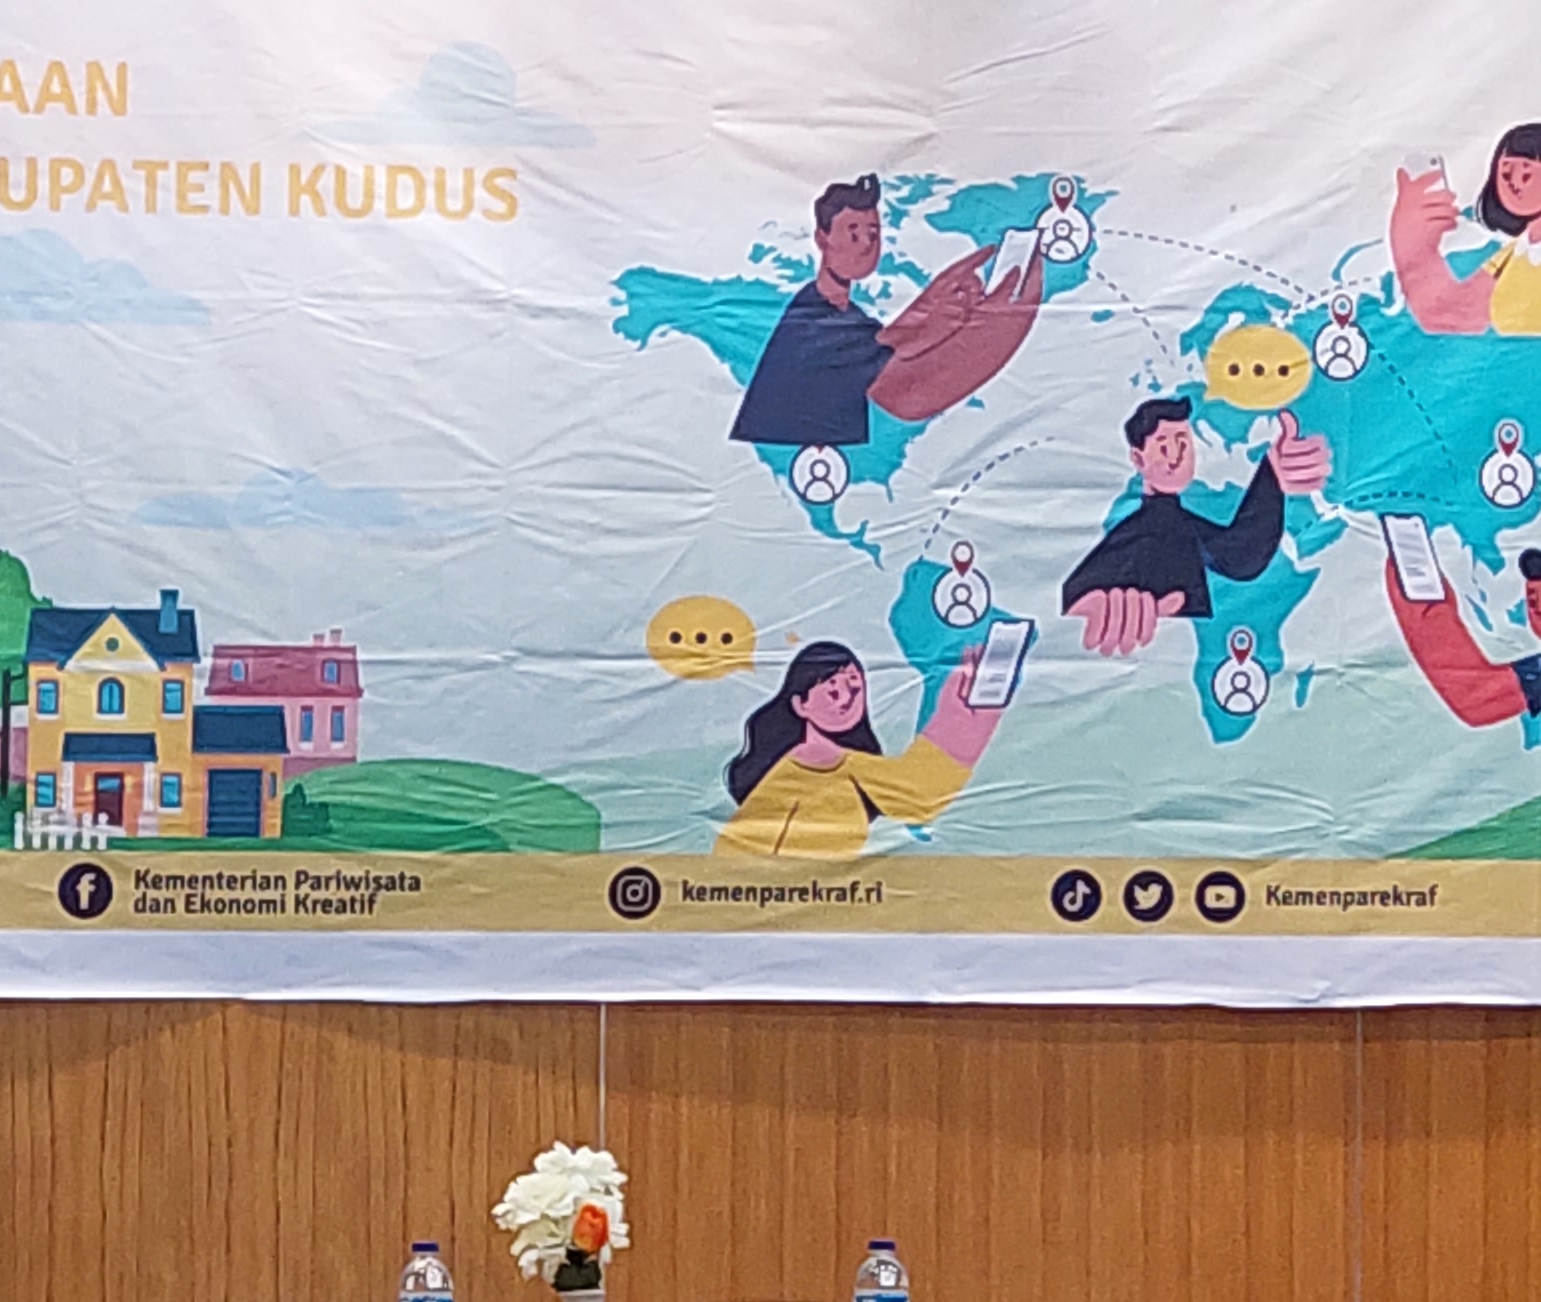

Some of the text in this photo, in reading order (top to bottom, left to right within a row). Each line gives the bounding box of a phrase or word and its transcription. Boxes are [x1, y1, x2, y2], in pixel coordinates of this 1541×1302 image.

[288, 163, 519, 222] KUDUS
[133, 868, 422, 893] Kementerian Pariwisata
[681, 879, 884, 908] kemenparekraf.ri
[133, 892, 379, 915] dan Ekonomi Kreatif
[1266, 884, 1439, 912] Kemenparekraf
